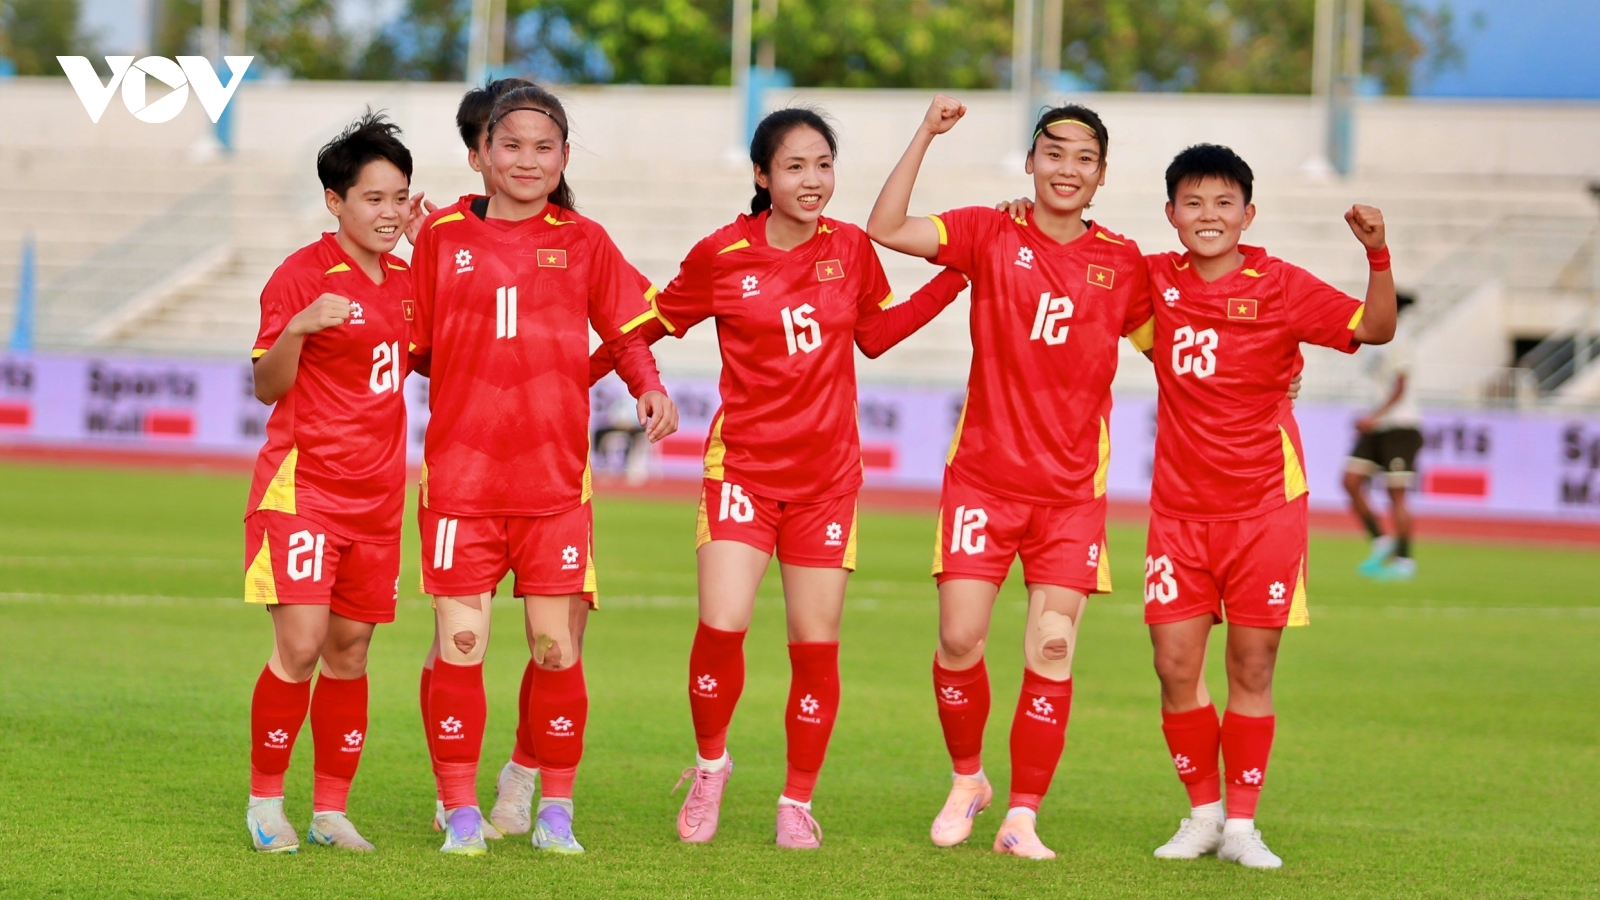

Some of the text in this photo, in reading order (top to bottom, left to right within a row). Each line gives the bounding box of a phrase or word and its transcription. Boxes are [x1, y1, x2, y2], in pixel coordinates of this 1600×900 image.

[497, 286, 517, 339] 11
[781, 303, 822, 356] 15
[1030, 292, 1074, 345] 12
[370, 341, 399, 394] 21
[1173, 326, 1218, 378] 23
[719, 482, 754, 522] 15
[287, 530, 325, 582] 21
[434, 518, 457, 570] 11
[951, 505, 988, 555] 12
[1144, 555, 1178, 604] 23
